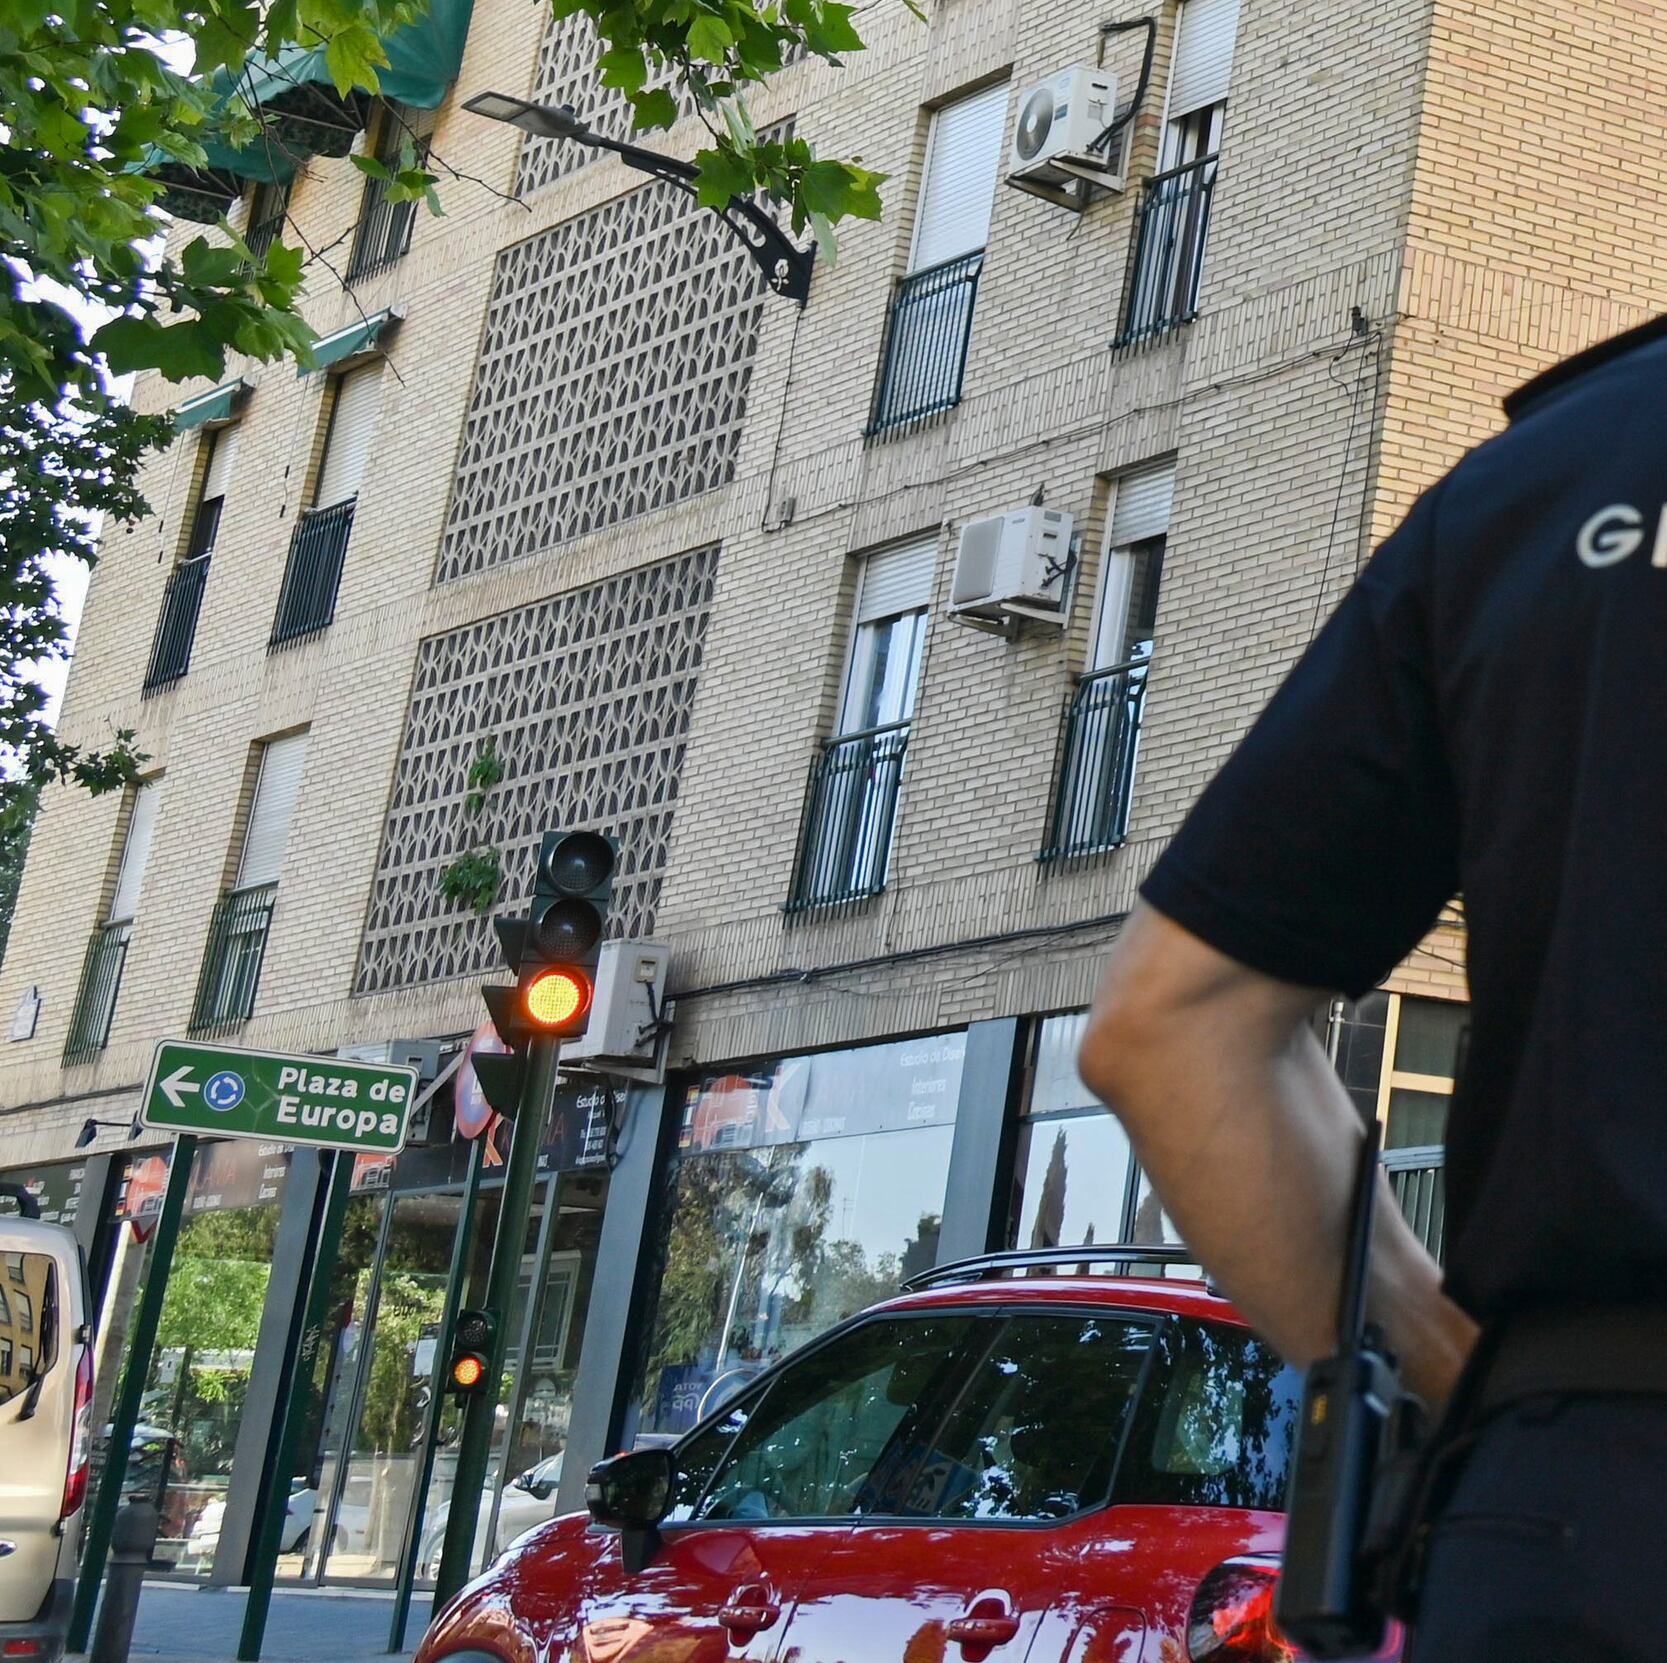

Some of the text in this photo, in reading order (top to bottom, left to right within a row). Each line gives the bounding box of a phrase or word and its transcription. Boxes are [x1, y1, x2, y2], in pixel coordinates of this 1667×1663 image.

[278, 1067, 406, 1103] Plaza de
[276, 1098, 397, 1137] Europa
